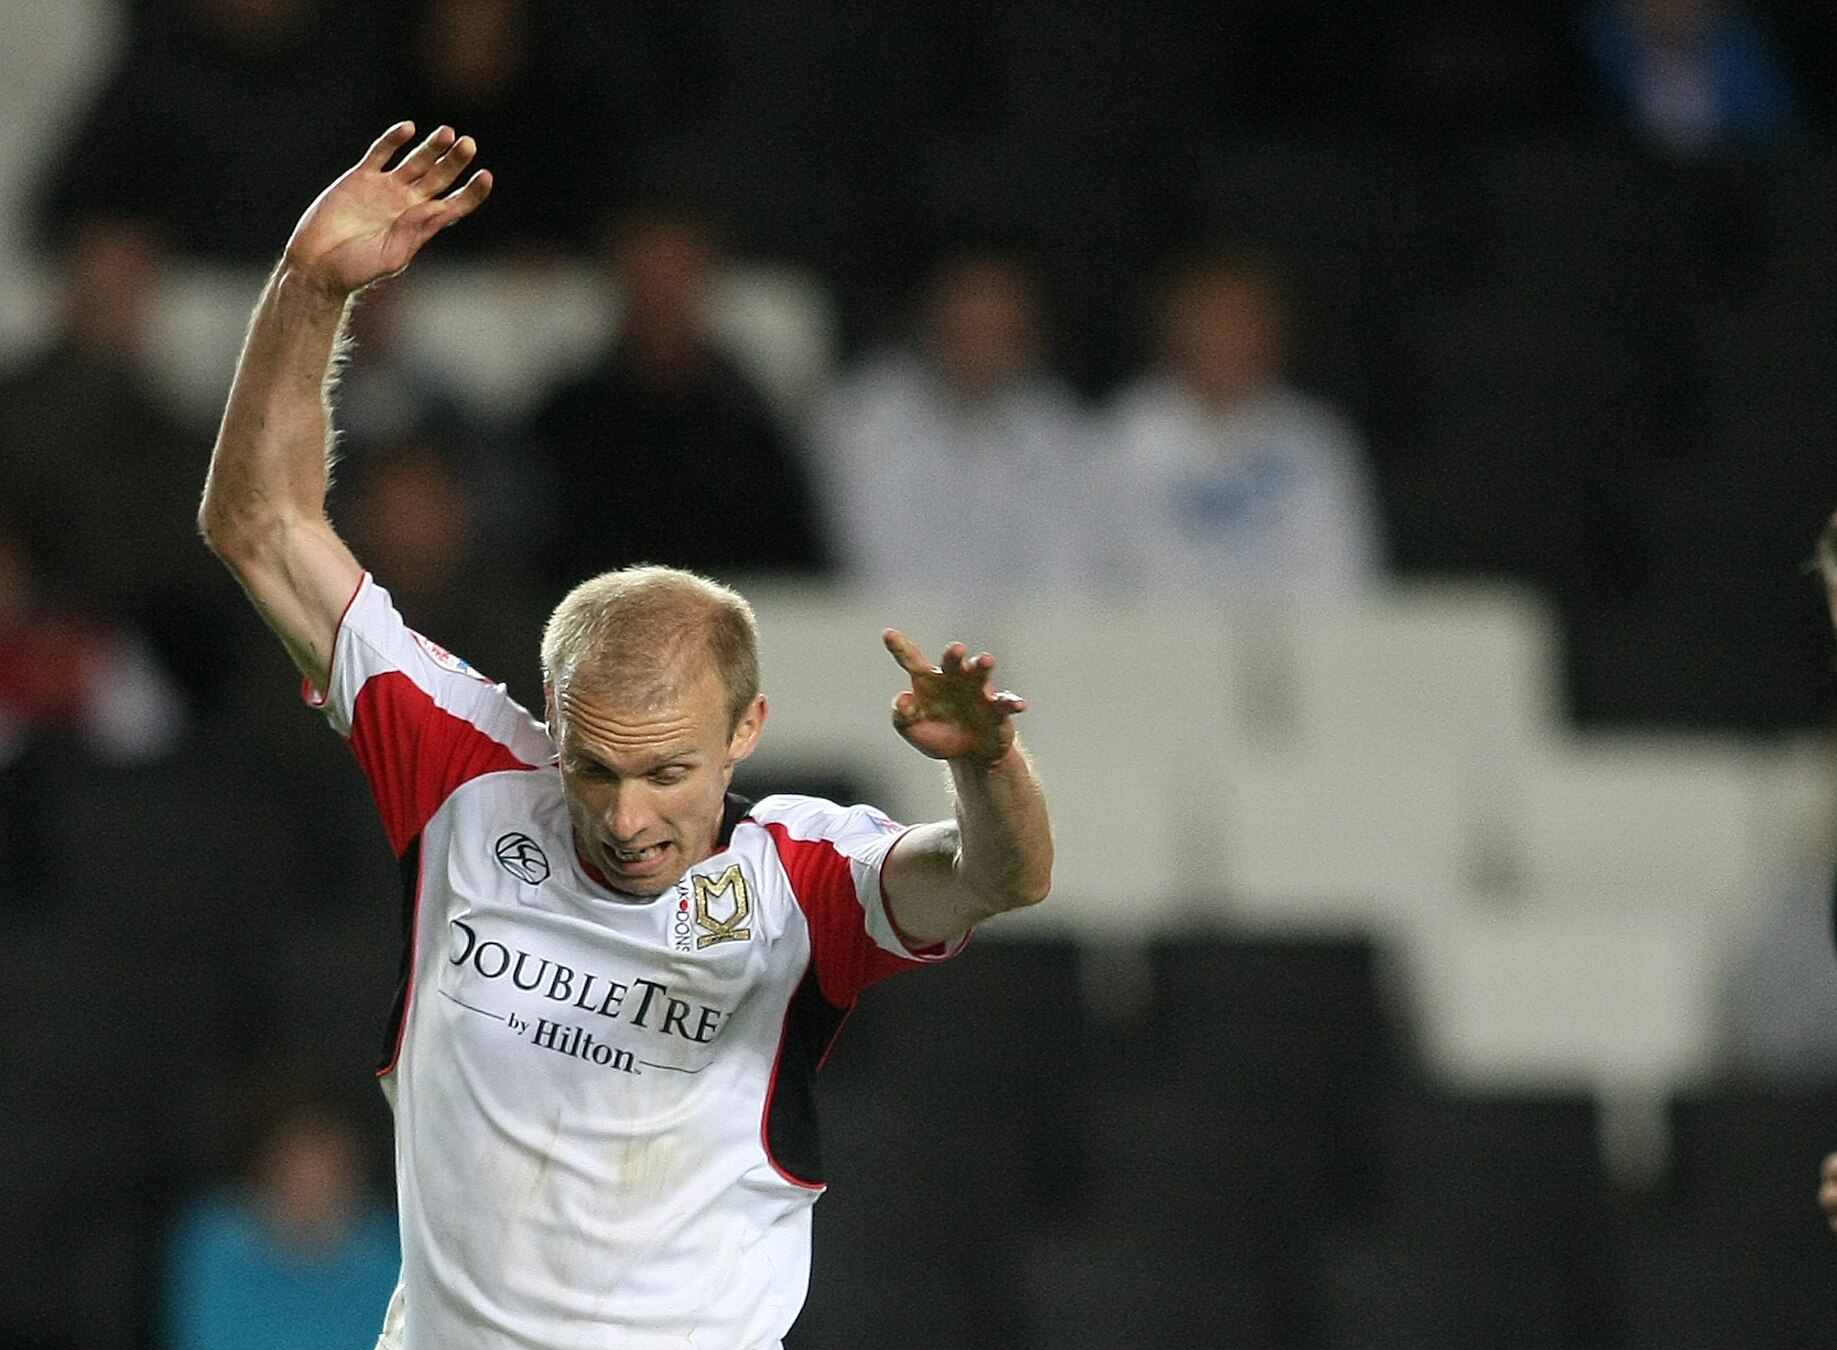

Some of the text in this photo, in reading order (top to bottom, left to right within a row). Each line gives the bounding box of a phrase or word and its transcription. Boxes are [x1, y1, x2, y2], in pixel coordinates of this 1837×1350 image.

[449, 918, 734, 1044] DOUBLETRE
[507, 1012, 641, 1074] by Hilton
